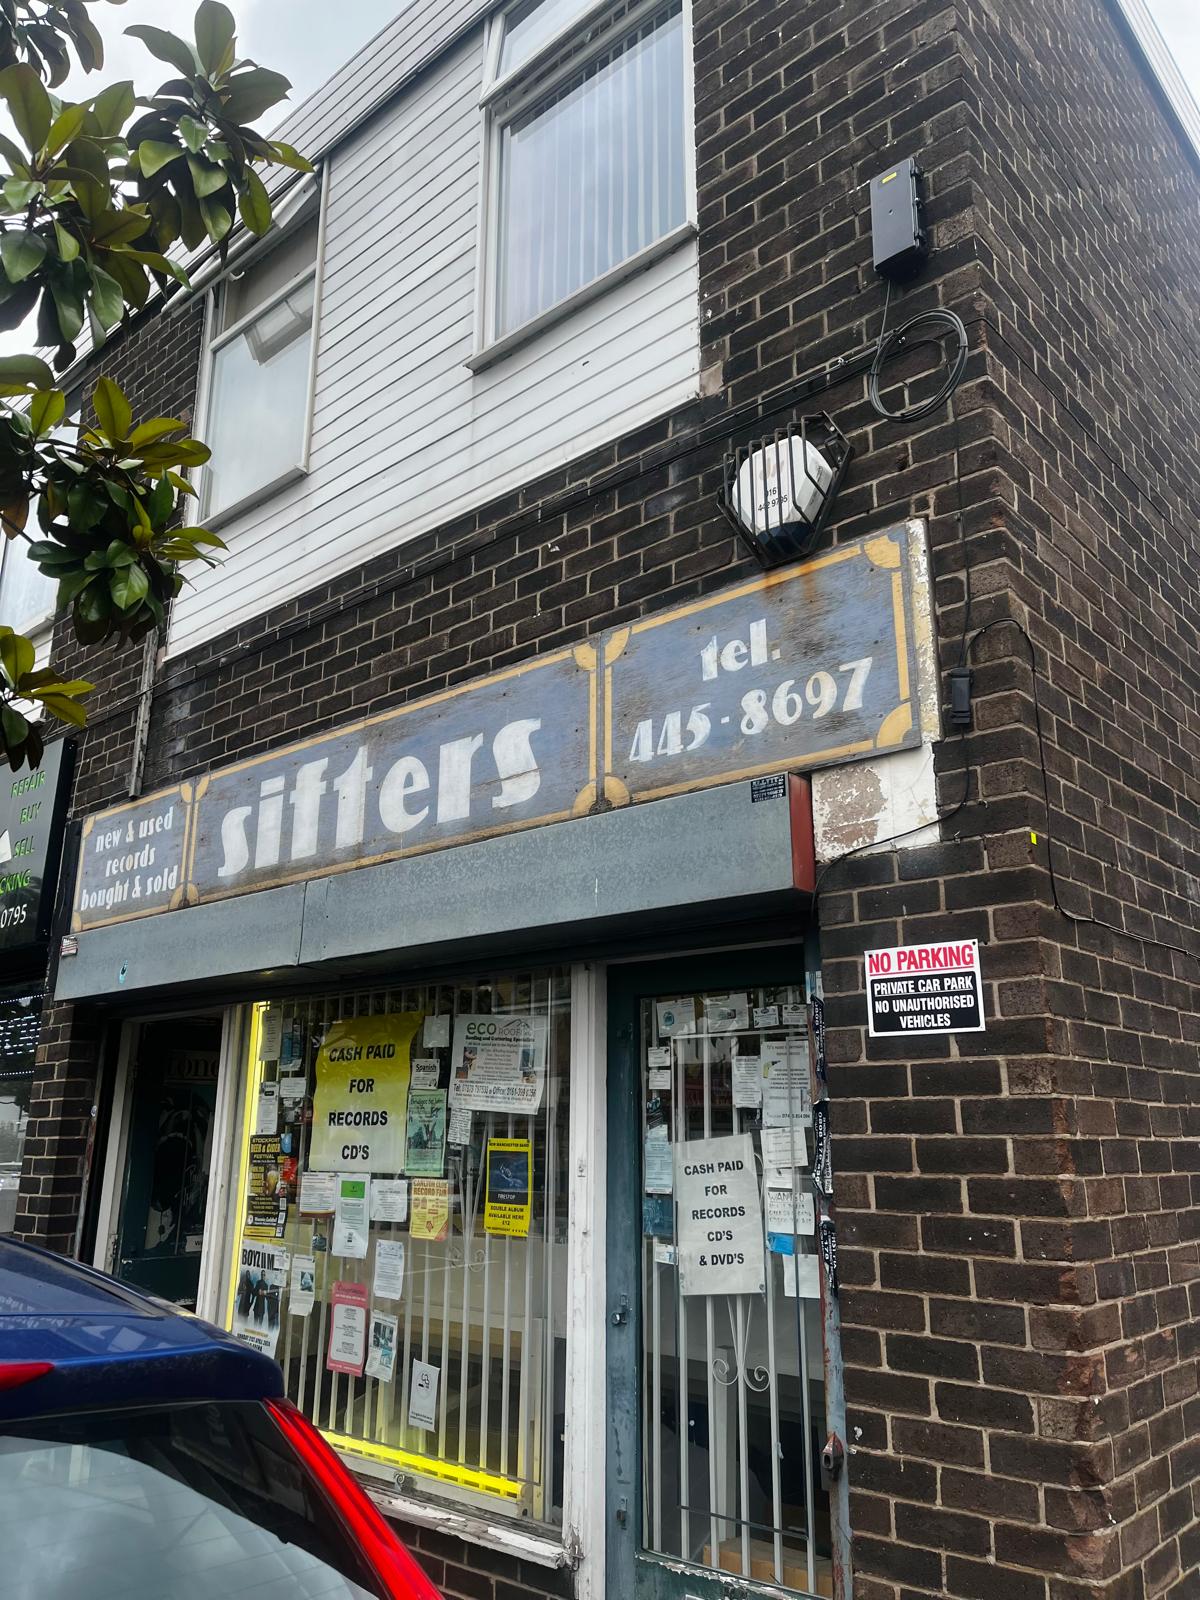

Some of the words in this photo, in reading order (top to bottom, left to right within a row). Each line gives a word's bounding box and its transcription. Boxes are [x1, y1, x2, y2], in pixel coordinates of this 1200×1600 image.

[701, 618, 781, 682] tel.
[11, 770, 46, 799] REPAIR
[217, 717, 542, 878] sifters
[20, 801, 42, 825] BUY
[95, 829, 122, 853] new
[125, 820, 135, 843] &
[139, 806, 174, 838] used
[13, 835, 35, 859] SELL
[105, 843, 156, 877] records
[81, 879, 129, 911] bought
[132, 875, 141, 898] &
[145, 865, 178, 895] sold
[0, 903, 28, 929] 0795
[868, 952, 892, 974] NO
[897, 944, 975, 971] PARKING
[873, 980, 915, 996] PRIVATE
[918, 978, 941, 993] CAR
[943, 976, 974, 990] PARK
[875, 1000, 890, 1014] NO
[892, 995, 975, 1013] UNAUTHORISED
[466, 1022, 497, 1035] eco
[899, 1013, 951, 1029] VEHICLES
[328, 1046, 363, 1062] CASH
[366, 1043, 396, 1059] PAID
[416, 1063, 437, 1073] Spanish
[349, 1078, 375, 1093] FOR
[328, 1111, 388, 1126] RECORDS
[341, 1145, 370, 1160] CD'S
[684, 1163, 714, 1176] CASH
[717, 1160, 744, 1172] PAID
[413, 1187, 435, 1195] RECORD
[704, 1184, 728, 1196] FOR
[691, 1206, 746, 1220] RECORDS
[707, 1230, 733, 1242] CD'S
[699, 1255, 707, 1266] &
[711, 1253, 745, 1266] DVD'S
